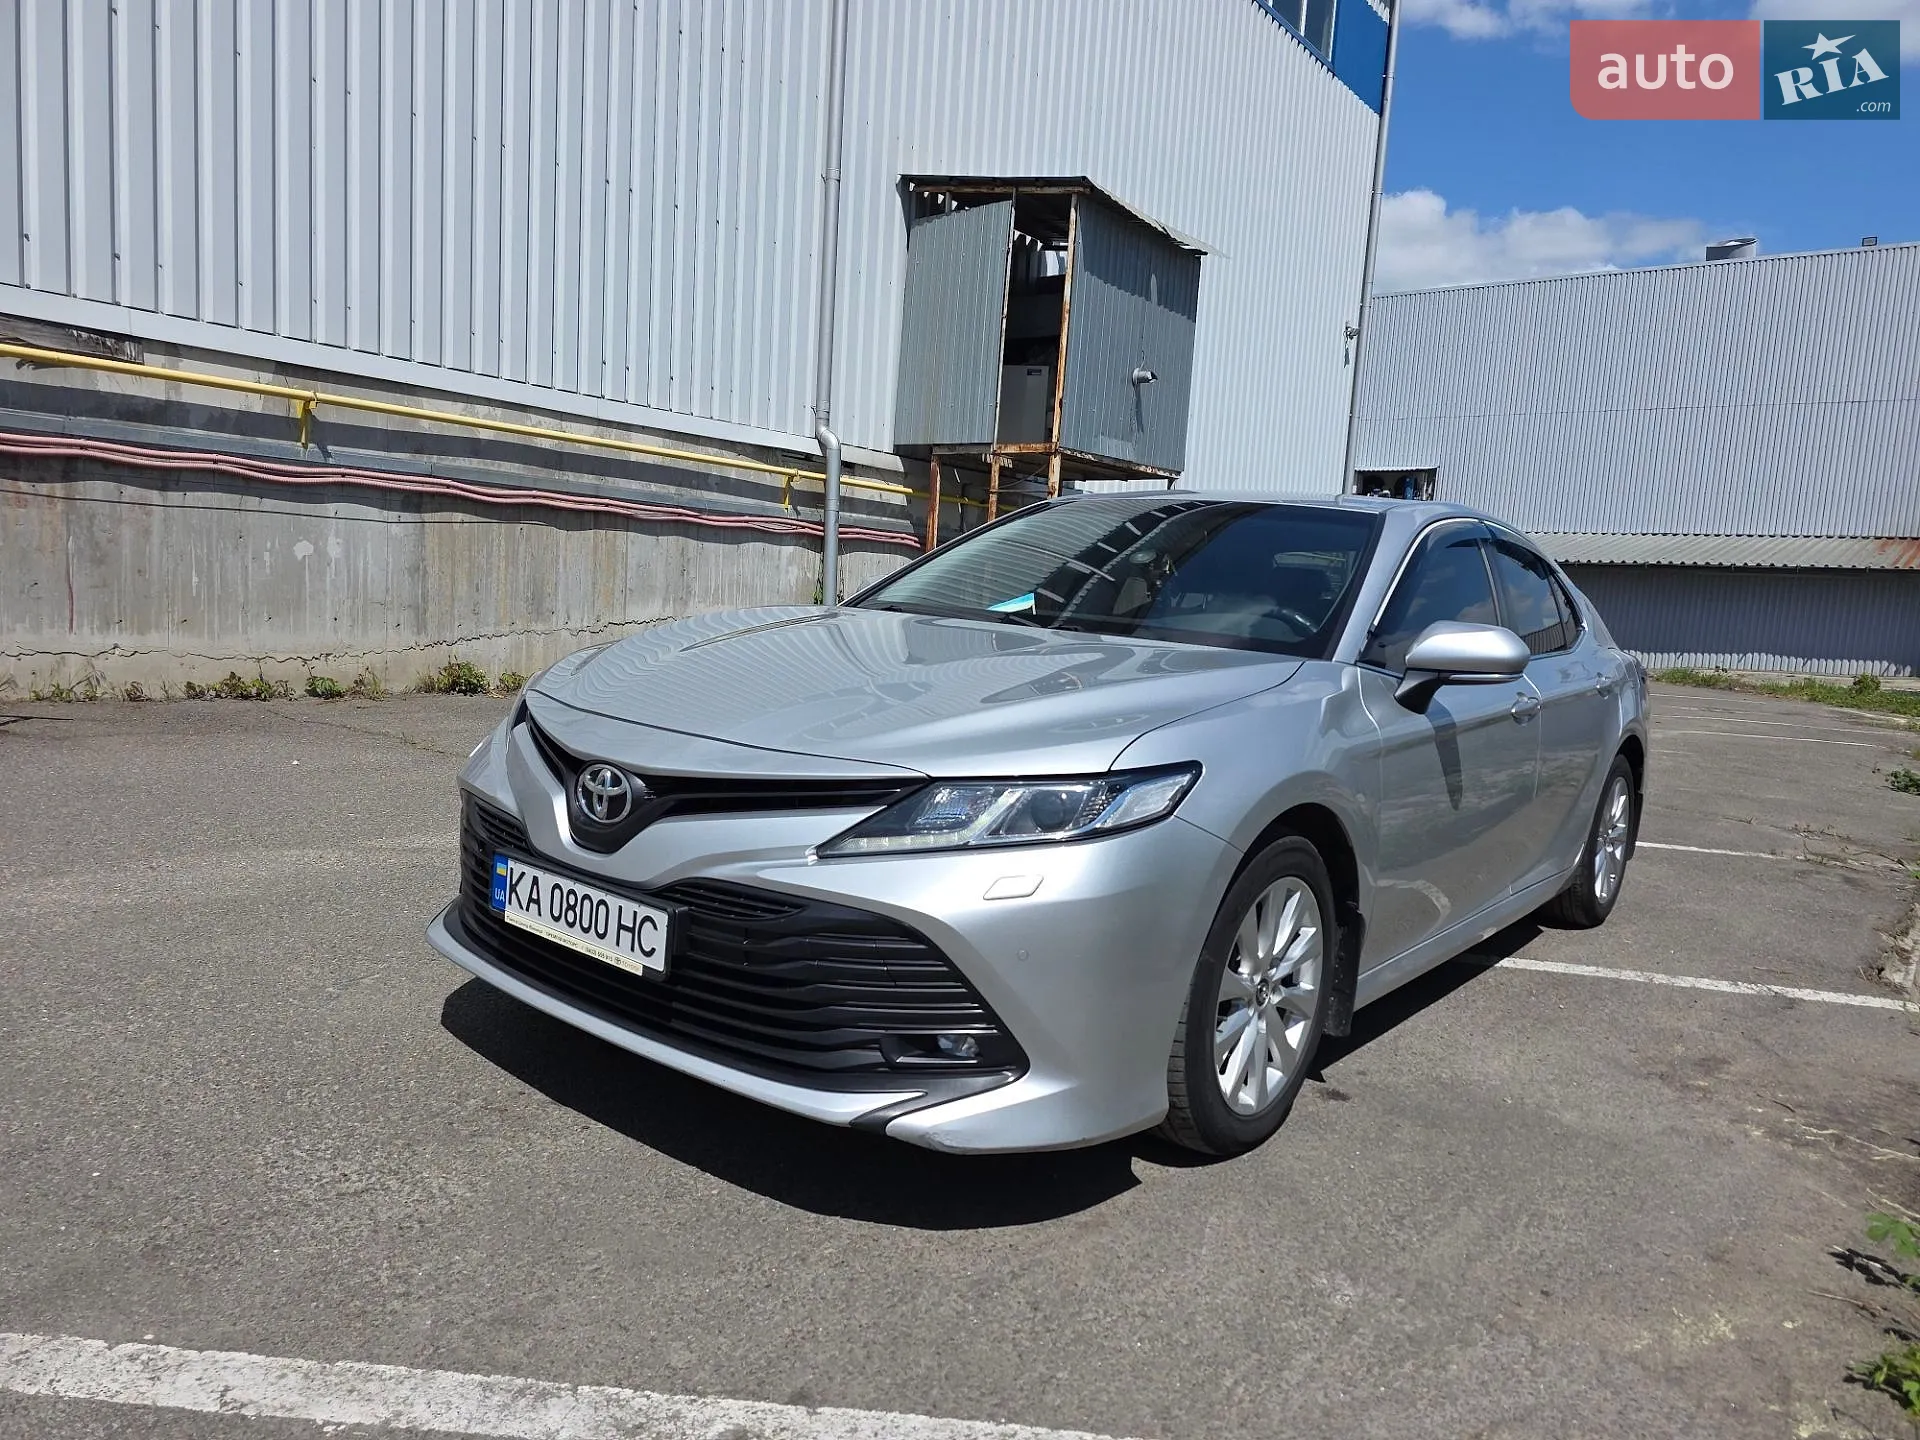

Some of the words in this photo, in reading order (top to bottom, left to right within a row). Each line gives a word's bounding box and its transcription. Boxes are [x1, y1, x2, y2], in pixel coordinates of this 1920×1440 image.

[494, 888, 505, 903] UA
[508, 867, 542, 917] KA
[550, 882, 610, 940] 0800
[616, 904, 659, 958] HC
